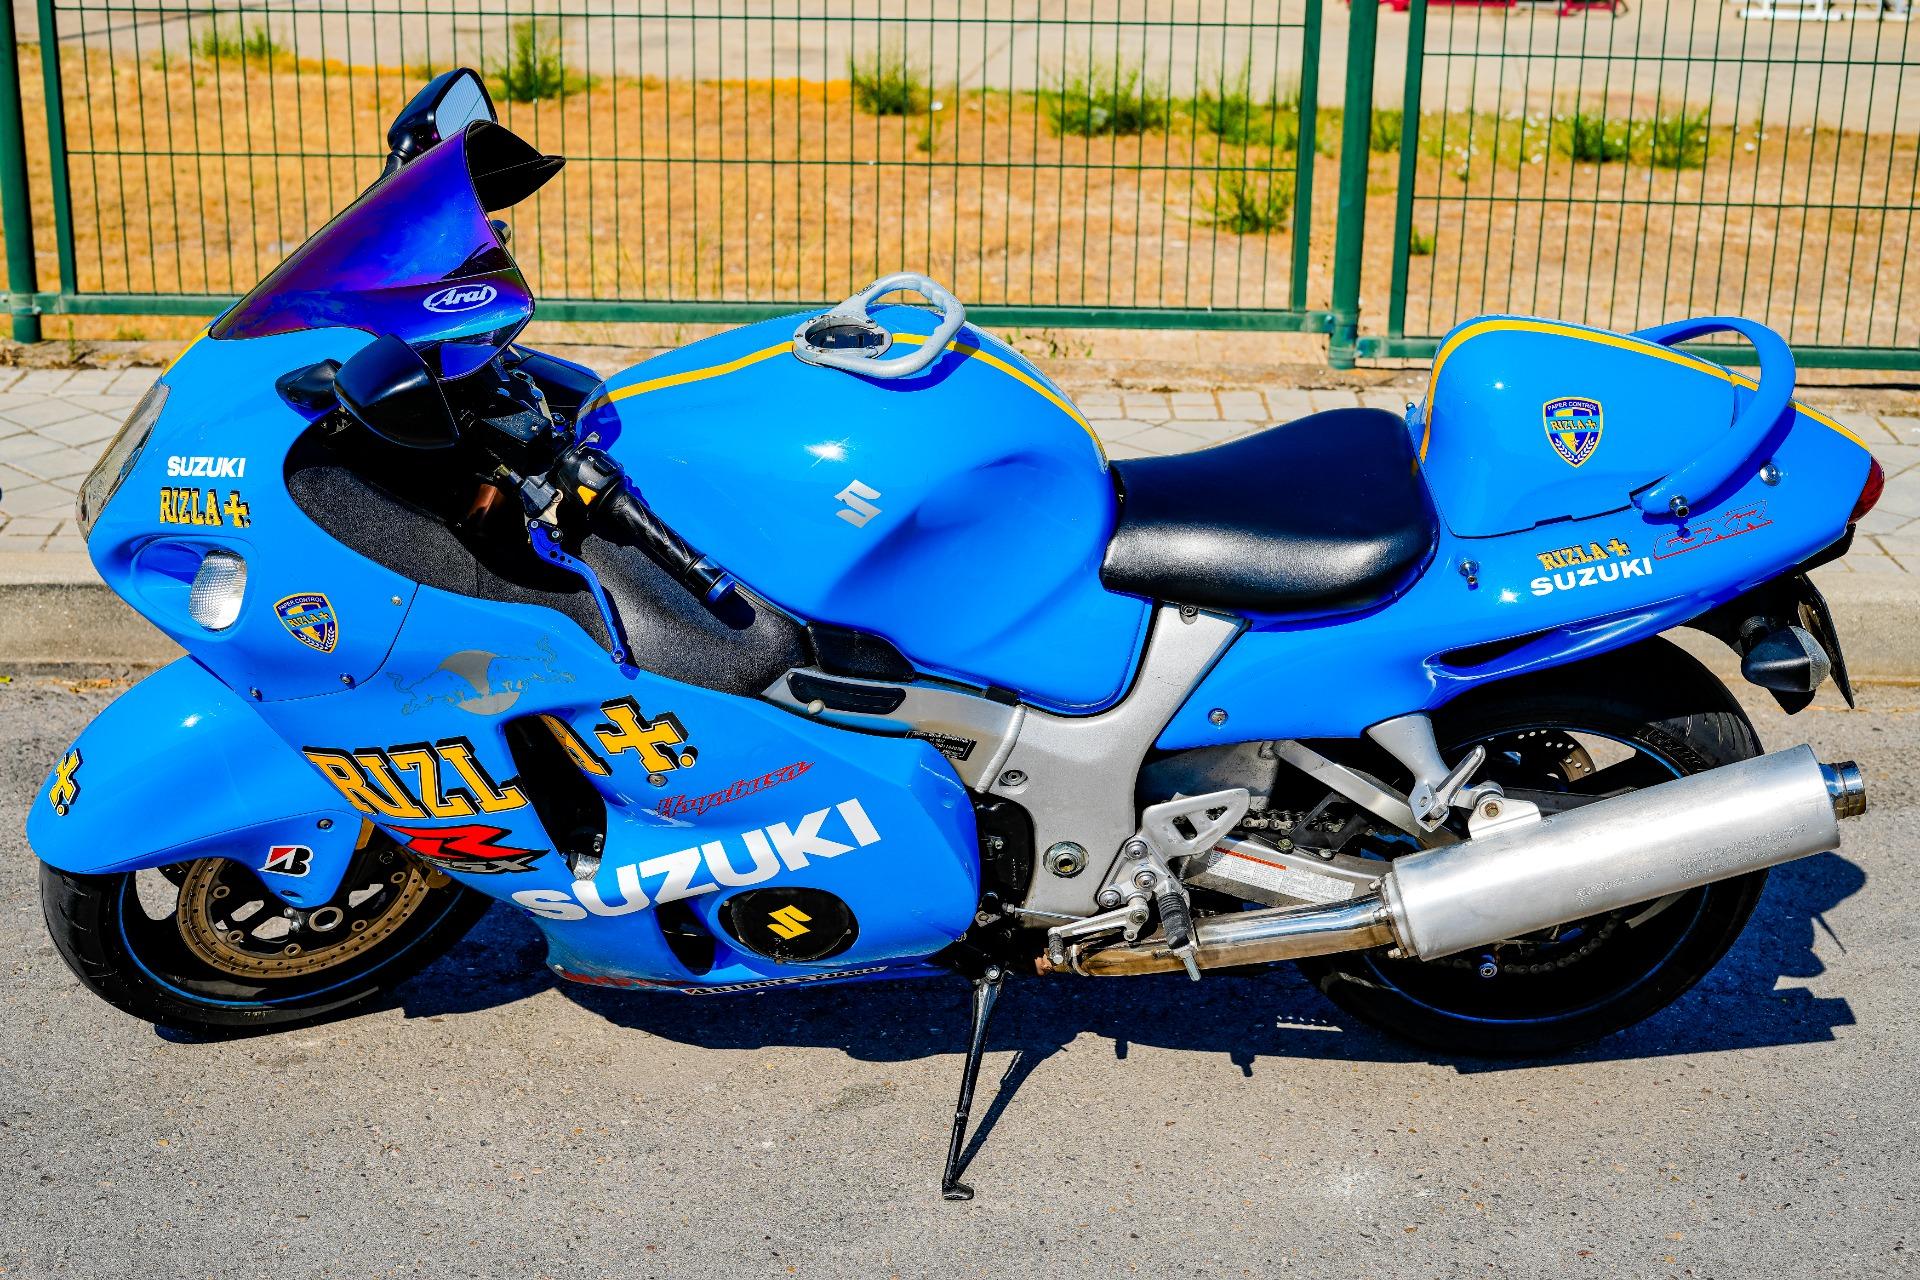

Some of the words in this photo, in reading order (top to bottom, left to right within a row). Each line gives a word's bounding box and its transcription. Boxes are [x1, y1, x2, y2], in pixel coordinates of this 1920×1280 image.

[429, 284, 488, 306] Arai
[167, 456, 246, 477] SUZUKI
[1530, 557, 1653, 597] SUZUKI
[511, 797, 882, 921] SUZUKI
